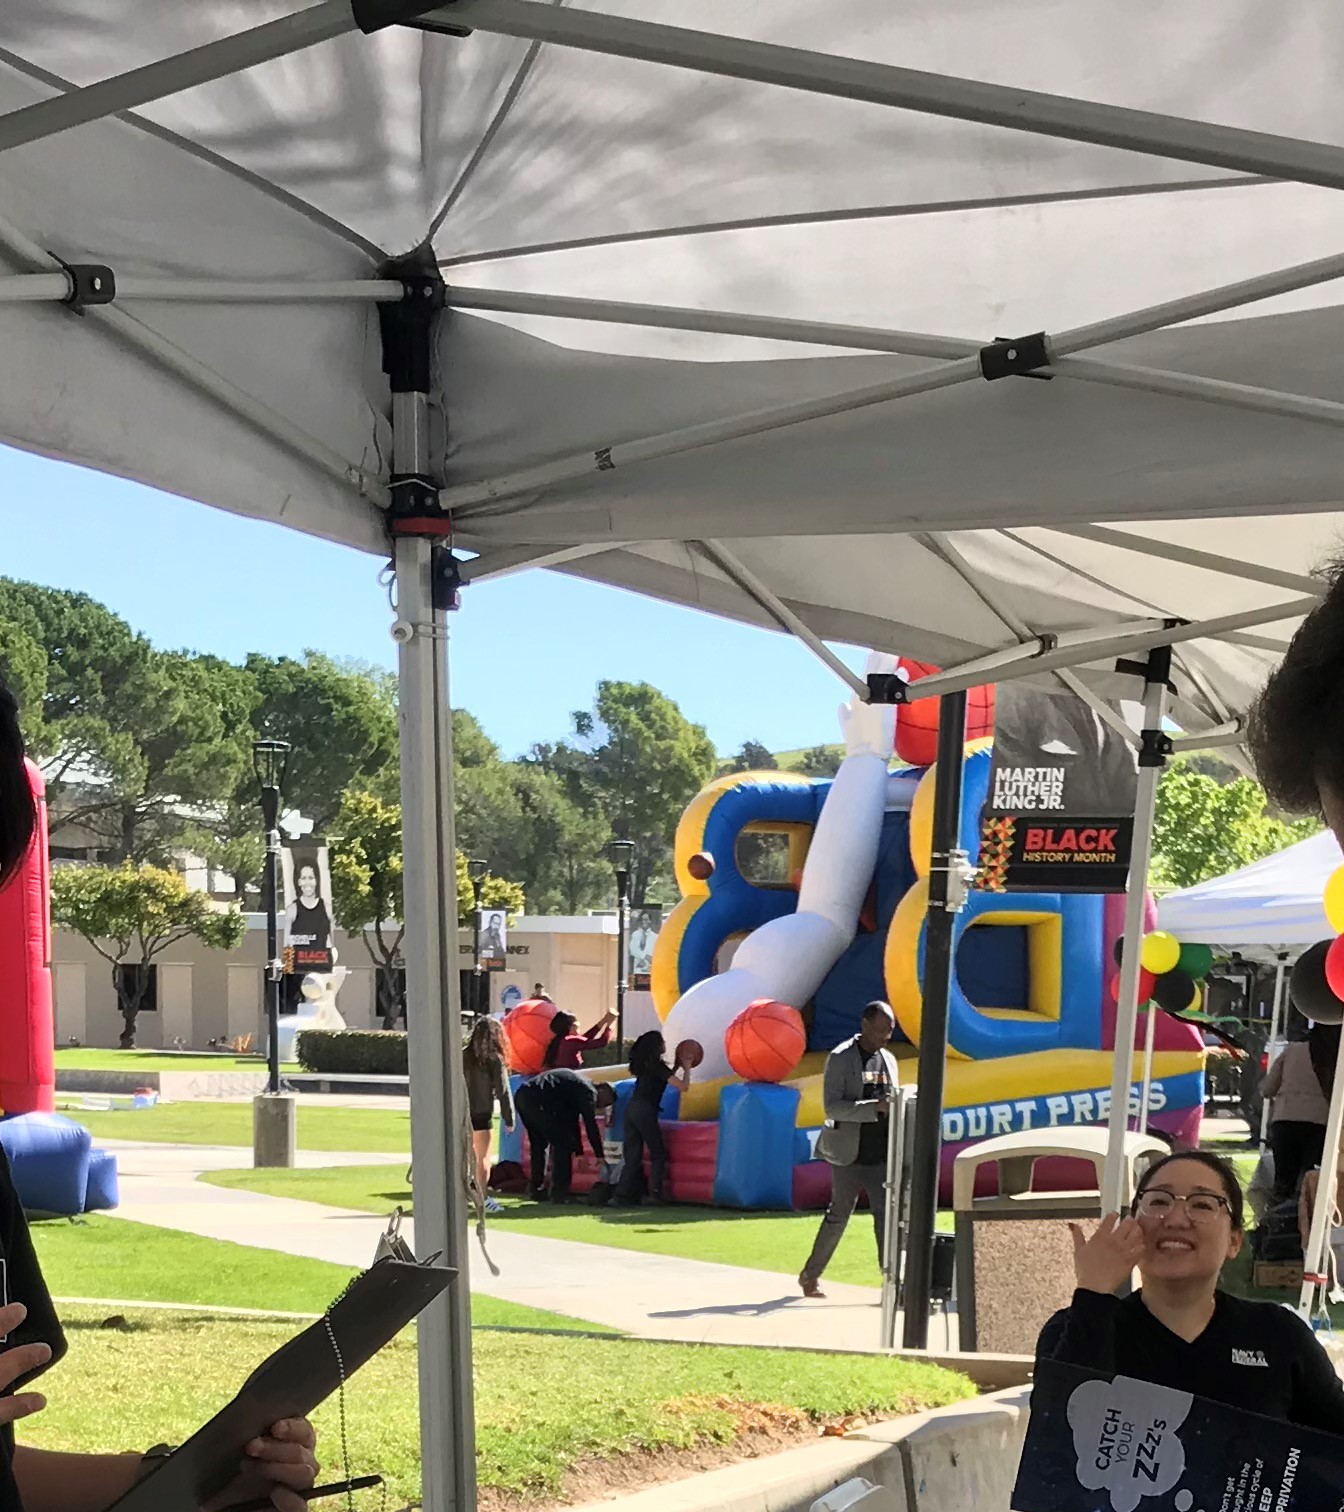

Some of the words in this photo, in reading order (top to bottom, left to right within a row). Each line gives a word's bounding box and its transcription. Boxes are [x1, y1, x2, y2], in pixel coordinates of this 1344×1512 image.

[996, 767, 1065, 782] MARTIN
[994, 781, 1064, 796] LUTHER
[992, 795, 1036, 810] KING
[1038, 795, 1065, 810] JR.
[1024, 828, 1119, 851] BLACK
[1022, 852, 1072, 863] HISTORY
[1073, 852, 1116, 863] MONTH
[941, 1099, 1038, 1142] OURT
[1095, 1408, 1122, 1470] CATCH
[1115, 1421, 1135, 1463] YOUR
[1244, 1462, 1252, 1478] the
[1255, 1458, 1264, 1469] of
[1226, 1476, 1236, 1493] get
[1241, 1478, 1248, 1489] in
[1250, 1468, 1262, 1492] cycle
